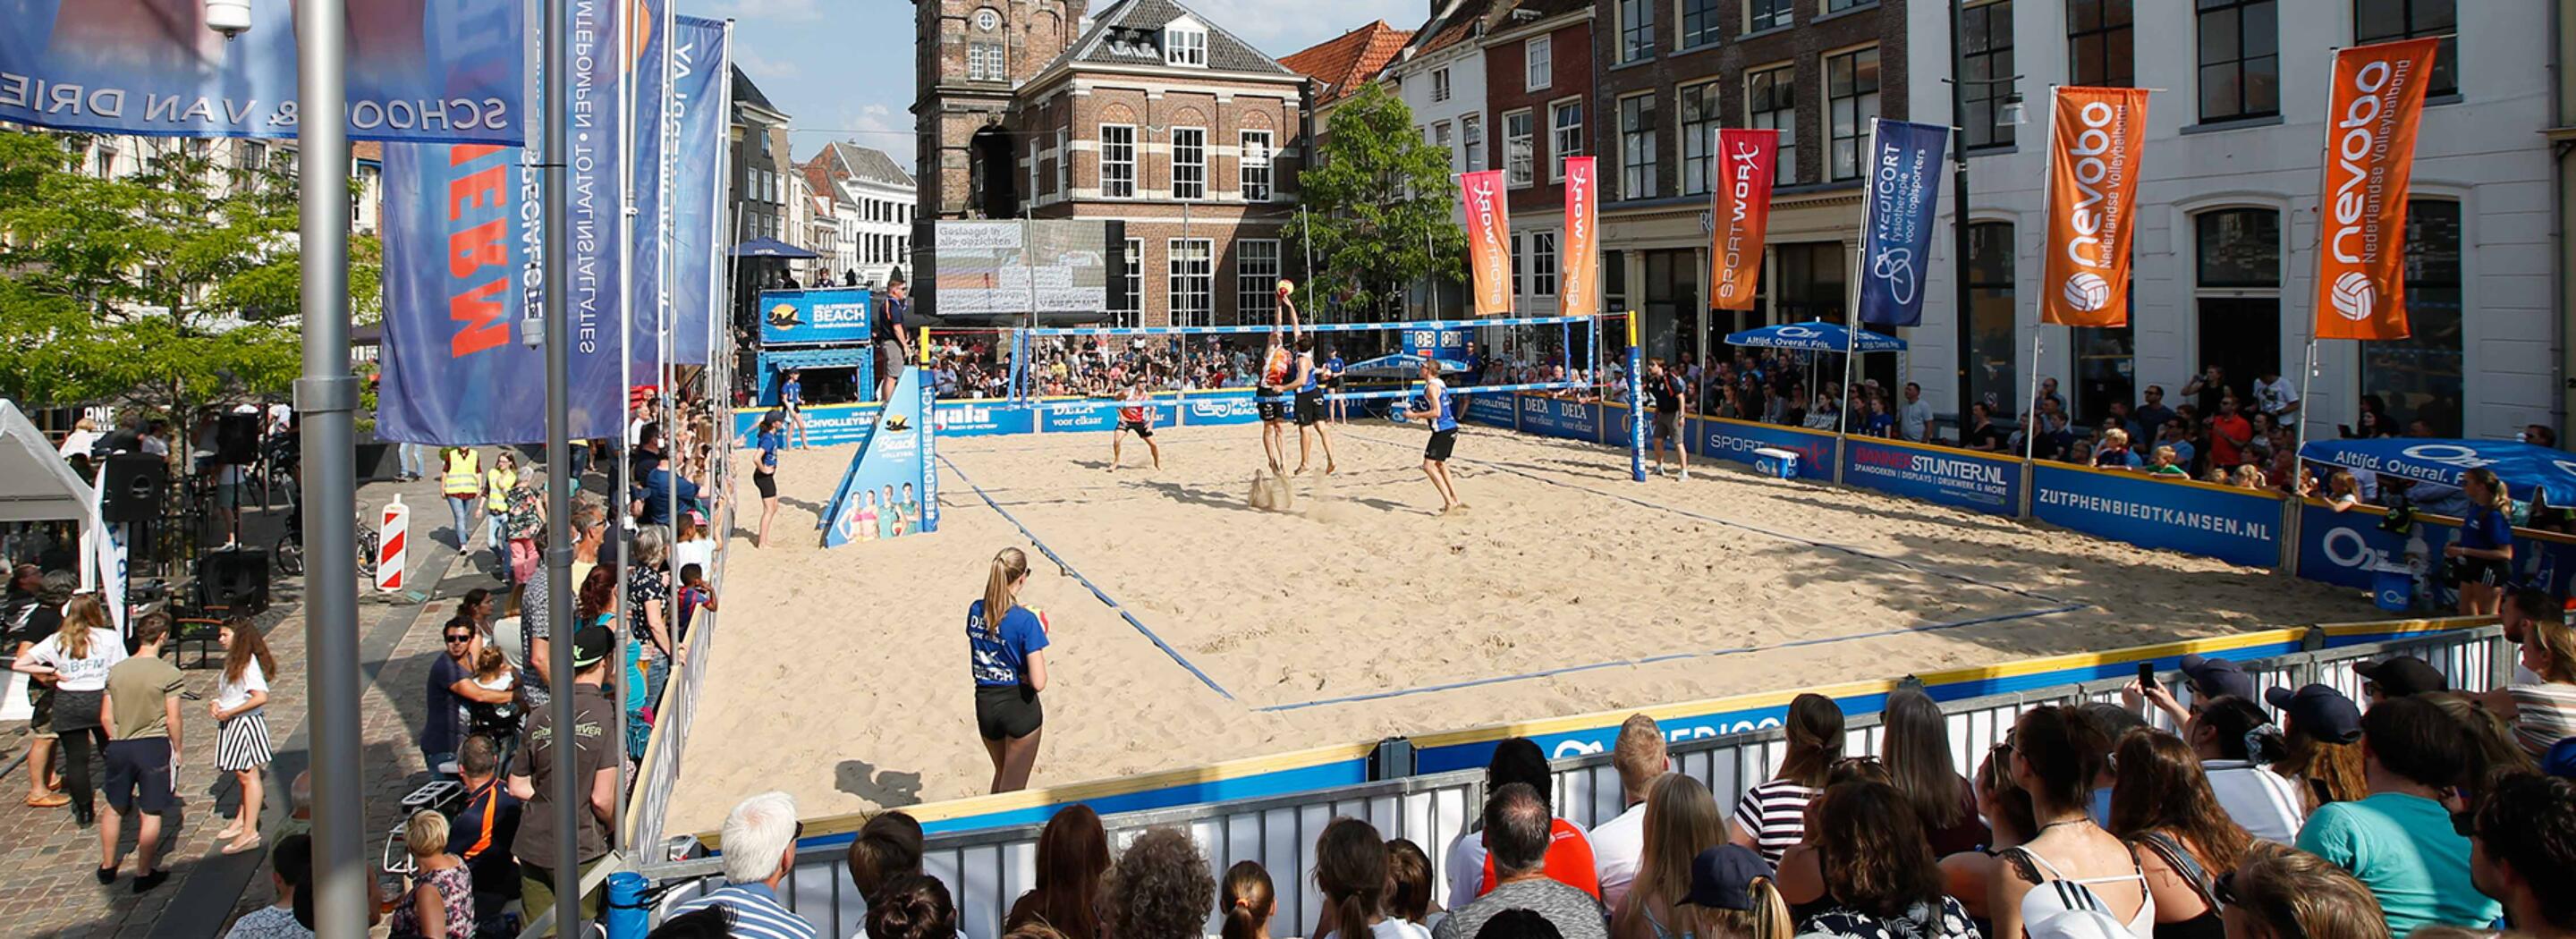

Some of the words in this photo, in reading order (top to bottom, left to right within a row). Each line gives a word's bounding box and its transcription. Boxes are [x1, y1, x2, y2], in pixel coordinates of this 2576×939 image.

[2371, 59, 2411, 164] Volleybalbond
[2106, 104, 2128, 189] Volleybalbond
[2332, 61, 2391, 264] nevobo
[1890, 172, 1909, 242] fysiotherapie
[2068, 101, 2113, 267] nevobo
[1719, 141, 1759, 299] SPORTWORX
[1905, 221, 1915, 243] voor
[2099, 192, 2119, 269] Nederlandse
[2362, 166, 2385, 264] Nederlandse
[813, 309, 865, 322] BEACH
[1745, 336, 1773, 346] Altijd.
[1775, 336, 1809, 348] Overal.
[1810, 339, 1831, 349] Fris.
[1053, 419, 1072, 427] voor
[1075, 417, 1102, 426] elkaar
[1525, 397, 1548, 413] DELA
[1561, 402, 1587, 419] DELA
[921, 386, 936, 520] #EREDIVISIEBEACH
[1854, 463, 1896, 477] SPANDOEKEN
[1902, 471, 1932, 484] DISPLAYS
[1937, 477, 1975, 490] DRUKWERK
[1984, 485, 2007, 495] MORE
[1855, 445, 2007, 485] BANNERSTUNTER.NL
[2334, 450, 2382, 471] Altijd.
[2386, 459, 2448, 484] Overal.
[2039, 488, 2271, 541] ZUTPHENBIEDTKANSEN.NL
